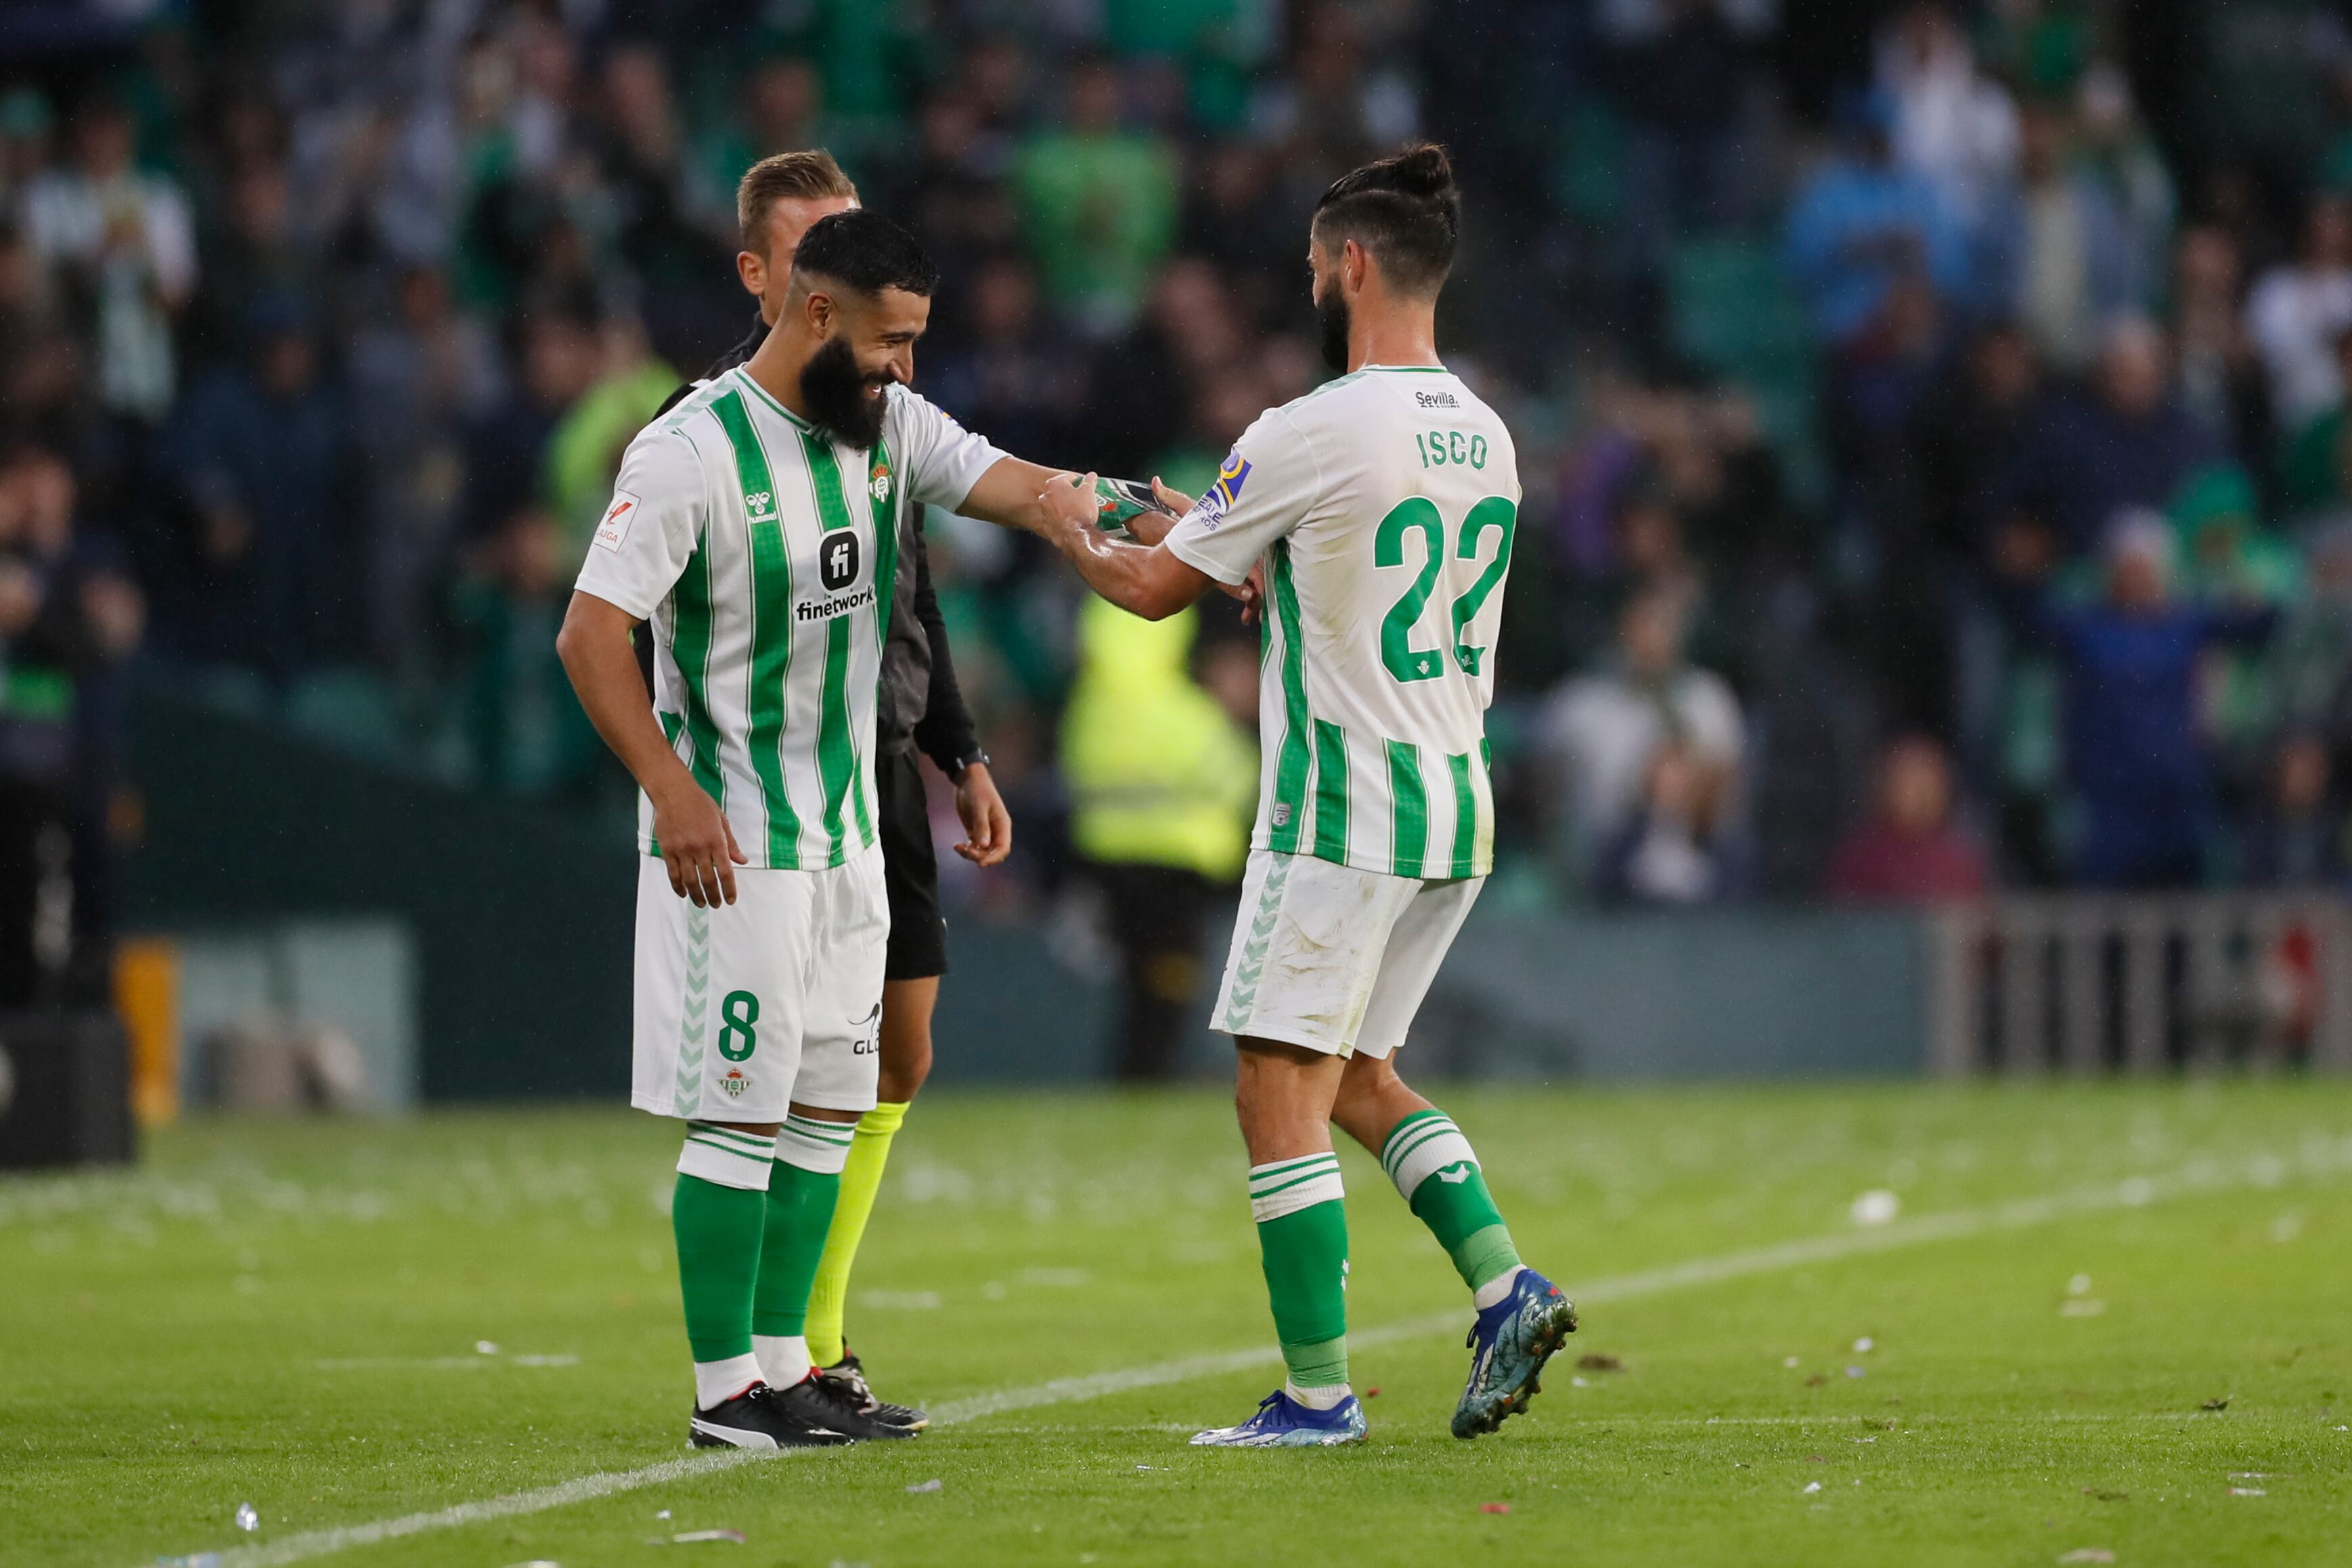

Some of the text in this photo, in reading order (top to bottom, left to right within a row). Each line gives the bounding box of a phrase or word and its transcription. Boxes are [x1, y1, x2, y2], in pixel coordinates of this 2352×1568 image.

[1415, 391, 1459, 405] Sevilla.
[1416, 430, 1488, 469] ISCO
[748, 511, 778, 524] hummel
[1197, 497, 1224, 524] EALE
[796, 585, 874, 621] finetwork
[1373, 495, 1517, 684] 22
[718, 989, 760, 1062] 8
